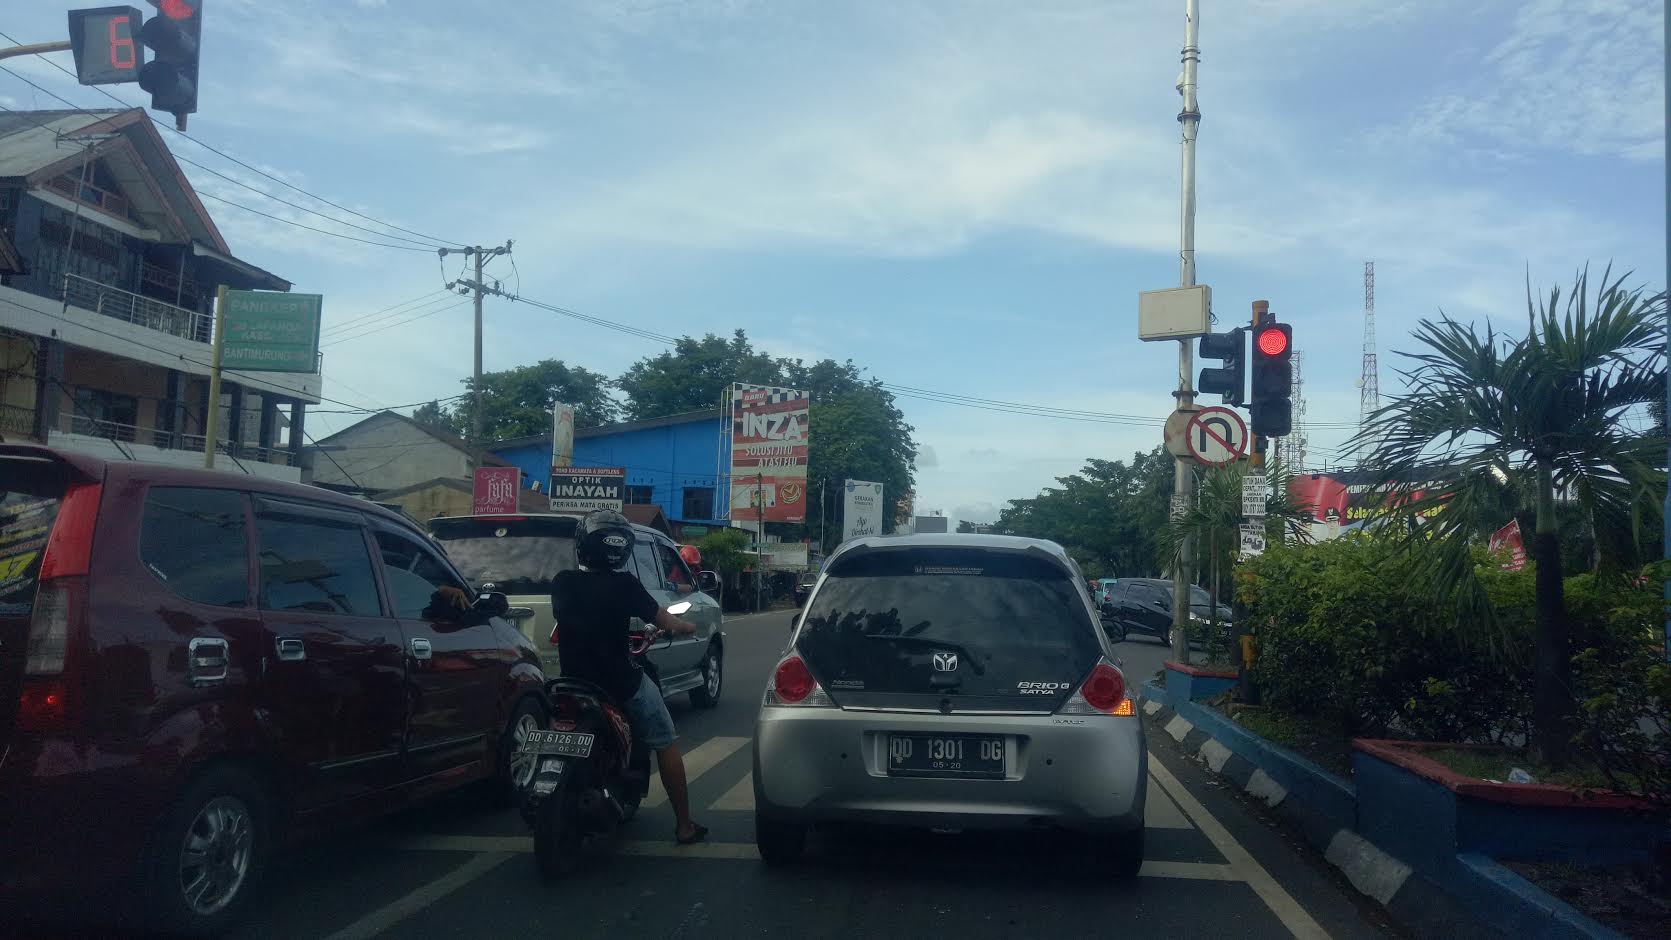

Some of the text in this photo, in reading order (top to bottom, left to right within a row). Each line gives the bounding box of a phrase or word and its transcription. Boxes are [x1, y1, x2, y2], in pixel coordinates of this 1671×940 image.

[109, 16, 136, 70] 6
[742, 411, 802, 441] INZA
[745, 445, 794, 456] SOLUSI JITU
[758, 457, 798, 468] ATASI FLU
[556, 485, 618, 498] INAYAH
[475, 505, 504, 515] parfume
[1017, 681, 1059, 690] BRIO
[527, 732, 542, 742] DD
[546, 734, 572, 744] 6126
[927, 738, 964, 760] 1301
[980, 740, 1003, 761] DG
